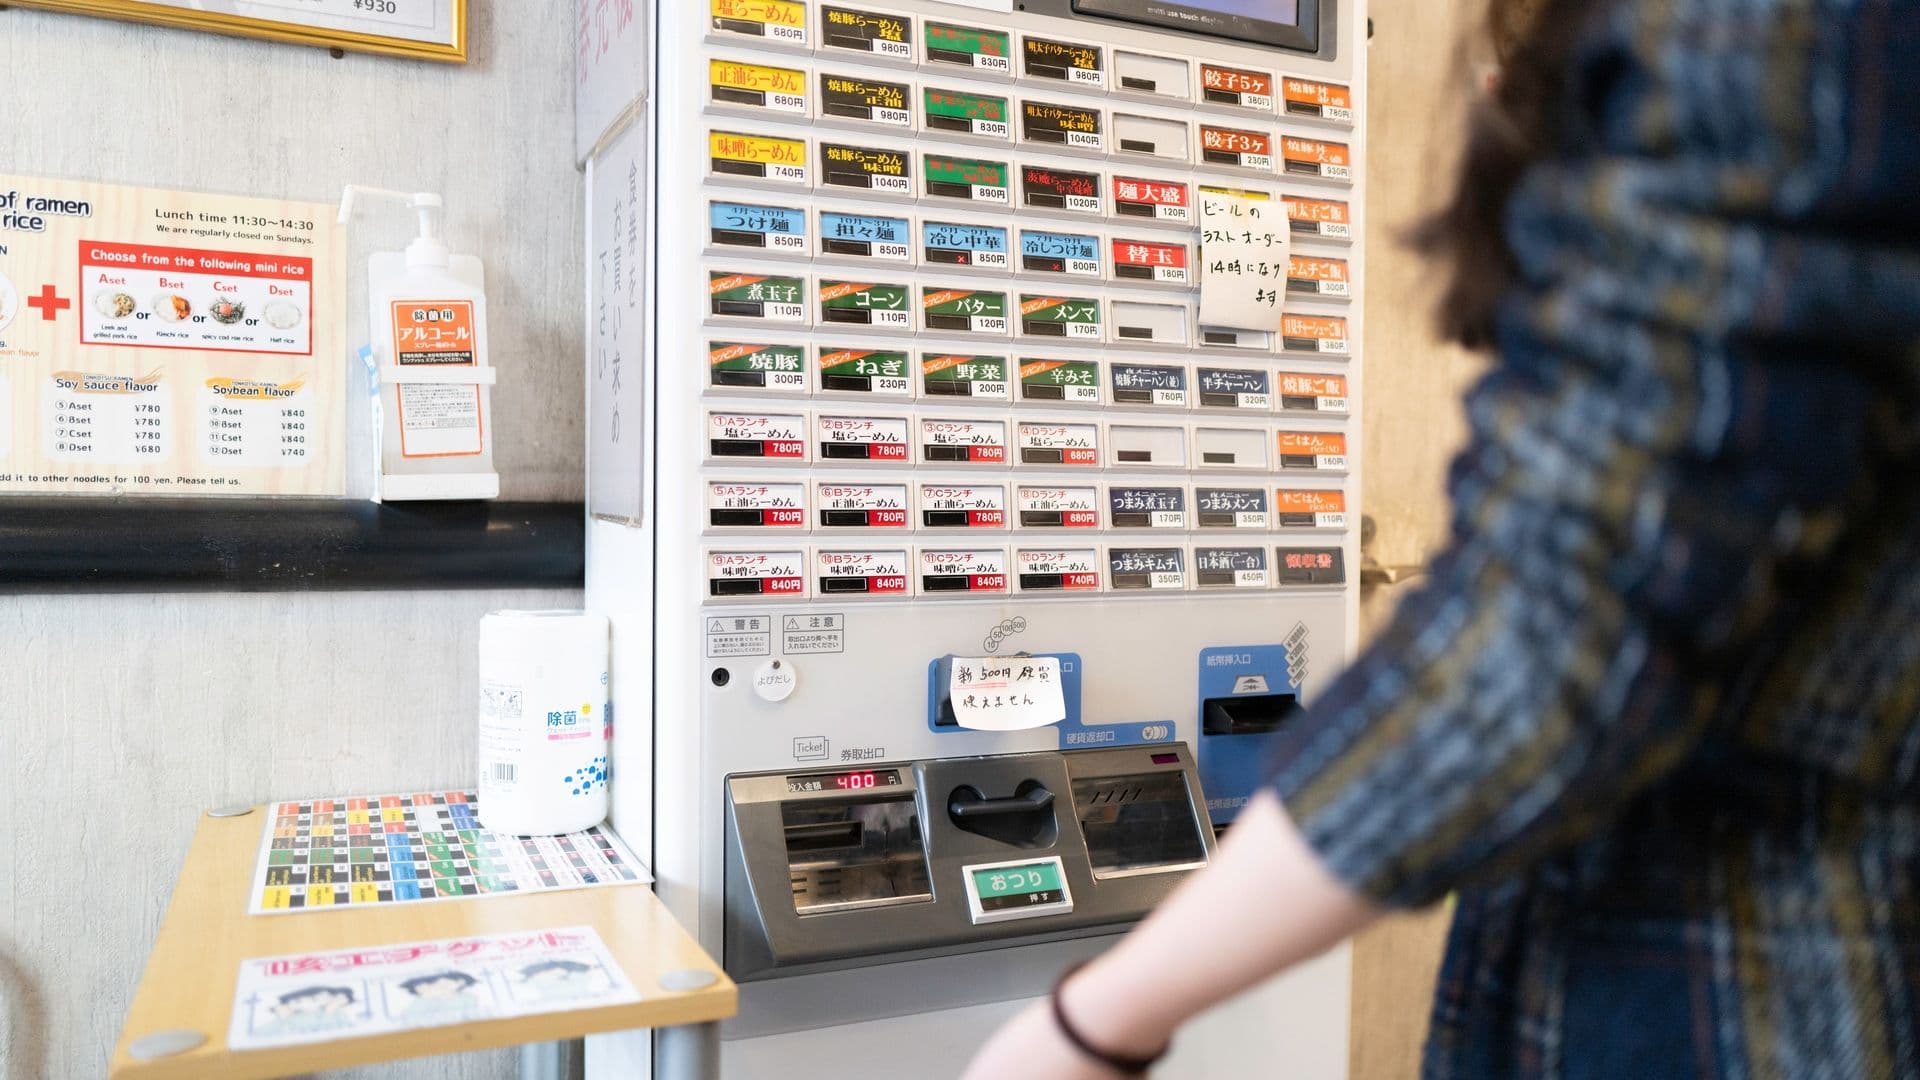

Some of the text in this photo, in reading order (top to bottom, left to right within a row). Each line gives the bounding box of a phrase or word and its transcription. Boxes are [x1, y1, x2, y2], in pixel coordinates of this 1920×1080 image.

[718, 0, 797, 24] 塩らーめん
[828, 11, 903, 32] 焼豚らーめん
[774, 28, 803, 40] 680円
[881, 42, 909, 54] 980円
[1028, 40, 1095, 60] 明太子バターらーめん
[981, 57, 1007, 69] 830円
[719, 66, 798, 91] 正油らーめん
[1075, 70, 1100, 82] 980円
[828, 79, 903, 99] 焼豚らーめん
[774, 95, 803, 107] 680円
[880, 110, 908, 122] 980円
[1027, 105, 1094, 123] 明太子バターらーめん
[980, 122, 1006, 134] 830円
[1070, 133, 1099, 145] 1040円
[718, 138, 798, 162] 味噌らーめん
[827, 147, 902, 166] 焼豚らーめん
[1247, 155, 1269, 166] 230円
[775, 166, 804, 179] 740円
[874, 177, 907, 189] 1040円
[979, 188, 1006, 200] 890円
[1118, 181, 1180, 204] 麺大盛
[26, 197, 90, 215] ramen
[1069, 198, 1098, 209] 1020円
[1204, 200, 1260, 218] ビールの
[155, 208, 193, 221] Lunch
[199, 212, 227, 223] time
[1163, 208, 1186, 218] 120円
[3, 211, 43, 230] rice
[725, 215, 790, 232] つけ麺
[156, 224, 170, 233] We
[172, 226, 188, 234] are
[190, 228, 231, 239] regularly
[233, 231, 261, 240] closed
[276, 235, 314, 245] Sundays.
[835, 224, 895, 240] 担々麺
[774, 236, 803, 248] 850円
[930, 233, 1000, 249] 冷し中華
[879, 245, 907, 256] 850円
[1026, 240, 1093, 258] 冷しつけ麺
[1127, 244, 1173, 264] 替玉
[90, 249, 304, 275] Choose from the following mini rice
[979, 254, 1005, 264] 850円
[1072, 261, 1097, 272] 800円
[1210, 260, 1280, 279] 14時になり
[98, 273, 127, 286] Aset
[1162, 269, 1184, 279] 180円
[159, 277, 184, 289] Bset
[213, 281, 238, 293] Cset
[269, 285, 293, 297] Dset
[747, 283, 798, 302] 煮玉子
[856, 291, 903, 309] コーン
[1256, 288, 1276, 307] ます
[774, 306, 802, 316] 110円
[956, 300, 1000, 315] バター
[1054, 305, 1095, 321] メンマ
[136, 311, 151, 320] or
[192, 314, 207, 323] or
[880, 313, 907, 323] 110円
[245, 318, 260, 327] or
[979, 319, 1004, 329] 120円
[399, 326, 470, 341] アルコール
[1074, 325, 1097, 335] 170円
[749, 353, 799, 371] 焼豚
[856, 358, 902, 376] ねぎ
[956, 364, 1000, 380] 野菜
[1050, 369, 1093, 385] 辛みそ
[56, 378, 158, 392] Soy sauce flavor
[775, 374, 803, 385] 300円
[880, 379, 907, 390] 230円
[1203, 377, 1263, 392] 半チャーハン
[213, 385, 295, 397] Soybean flavor
[979, 383, 1005, 393] 200円
[1077, 388, 1096, 397] 80円
[1245, 395, 1267, 405] 320円
[724, 427, 796, 439] 塩らーめん
[832, 430, 899, 442] 塩らーめん
[933, 433, 997, 444] 塩らーめん
[773, 443, 801, 453] 780円
[1030, 437, 1089, 447] 塩らーめん
[877, 446, 905, 456] 780円
[976, 447, 1002, 457] 780円
[1070, 451, 1095, 460] 680円
[16, 474, 23, 482] it
[42, 475, 68, 483] other
[73, 475, 110, 483] noodles
[114, 475, 127, 484] for
[133, 476, 150, 484] 100
[177, 477, 206, 485] Please
[210, 477, 225, 485] tell
[724, 497, 795, 508] 正油らーめん
[832, 497, 899, 508] 正油らーめん
[933, 499, 997, 509] 正油らーめん
[1030, 500, 1089, 509] 正油らーめん
[1113, 497, 1178, 510] つまみ煮玉子
[1200, 498, 1260, 510] つまみメンマ
[772, 511, 801, 522] 780円
[877, 511, 904, 522] 780円
[976, 512, 1002, 523] 780円
[1070, 513, 1095, 523] 680円
[1159, 514, 1182, 523] 170円
[830, 564, 899, 575] 味噌らーめん
[933, 564, 997, 573] 味噌らーめん
[1029, 562, 1089, 572] 味噌らーめん
[1112, 558, 1176, 571] つまみキムチ
[722, 566, 795, 576] 味噌らーめん
[1241, 572, 1264, 582] 450円
[771, 579, 801, 590] 840円
[877, 578, 904, 588] 840円
[977, 577, 1003, 587] 840円
[1070, 575, 1095, 585] 740円
[1158, 575, 1181, 584] 350円
[809, 616, 834, 628] 注意
[758, 674, 791, 686] よびだし
[963, 693, 1034, 709] 使えません
[547, 711, 577, 726] 除菌
[796, 740, 822, 752] Ticket
[841, 748, 885, 761] 券取出口
[838, 774, 897, 789] 400 円
[990, 871, 1043, 891] おつり
[1030, 893, 1049, 903] 押す
